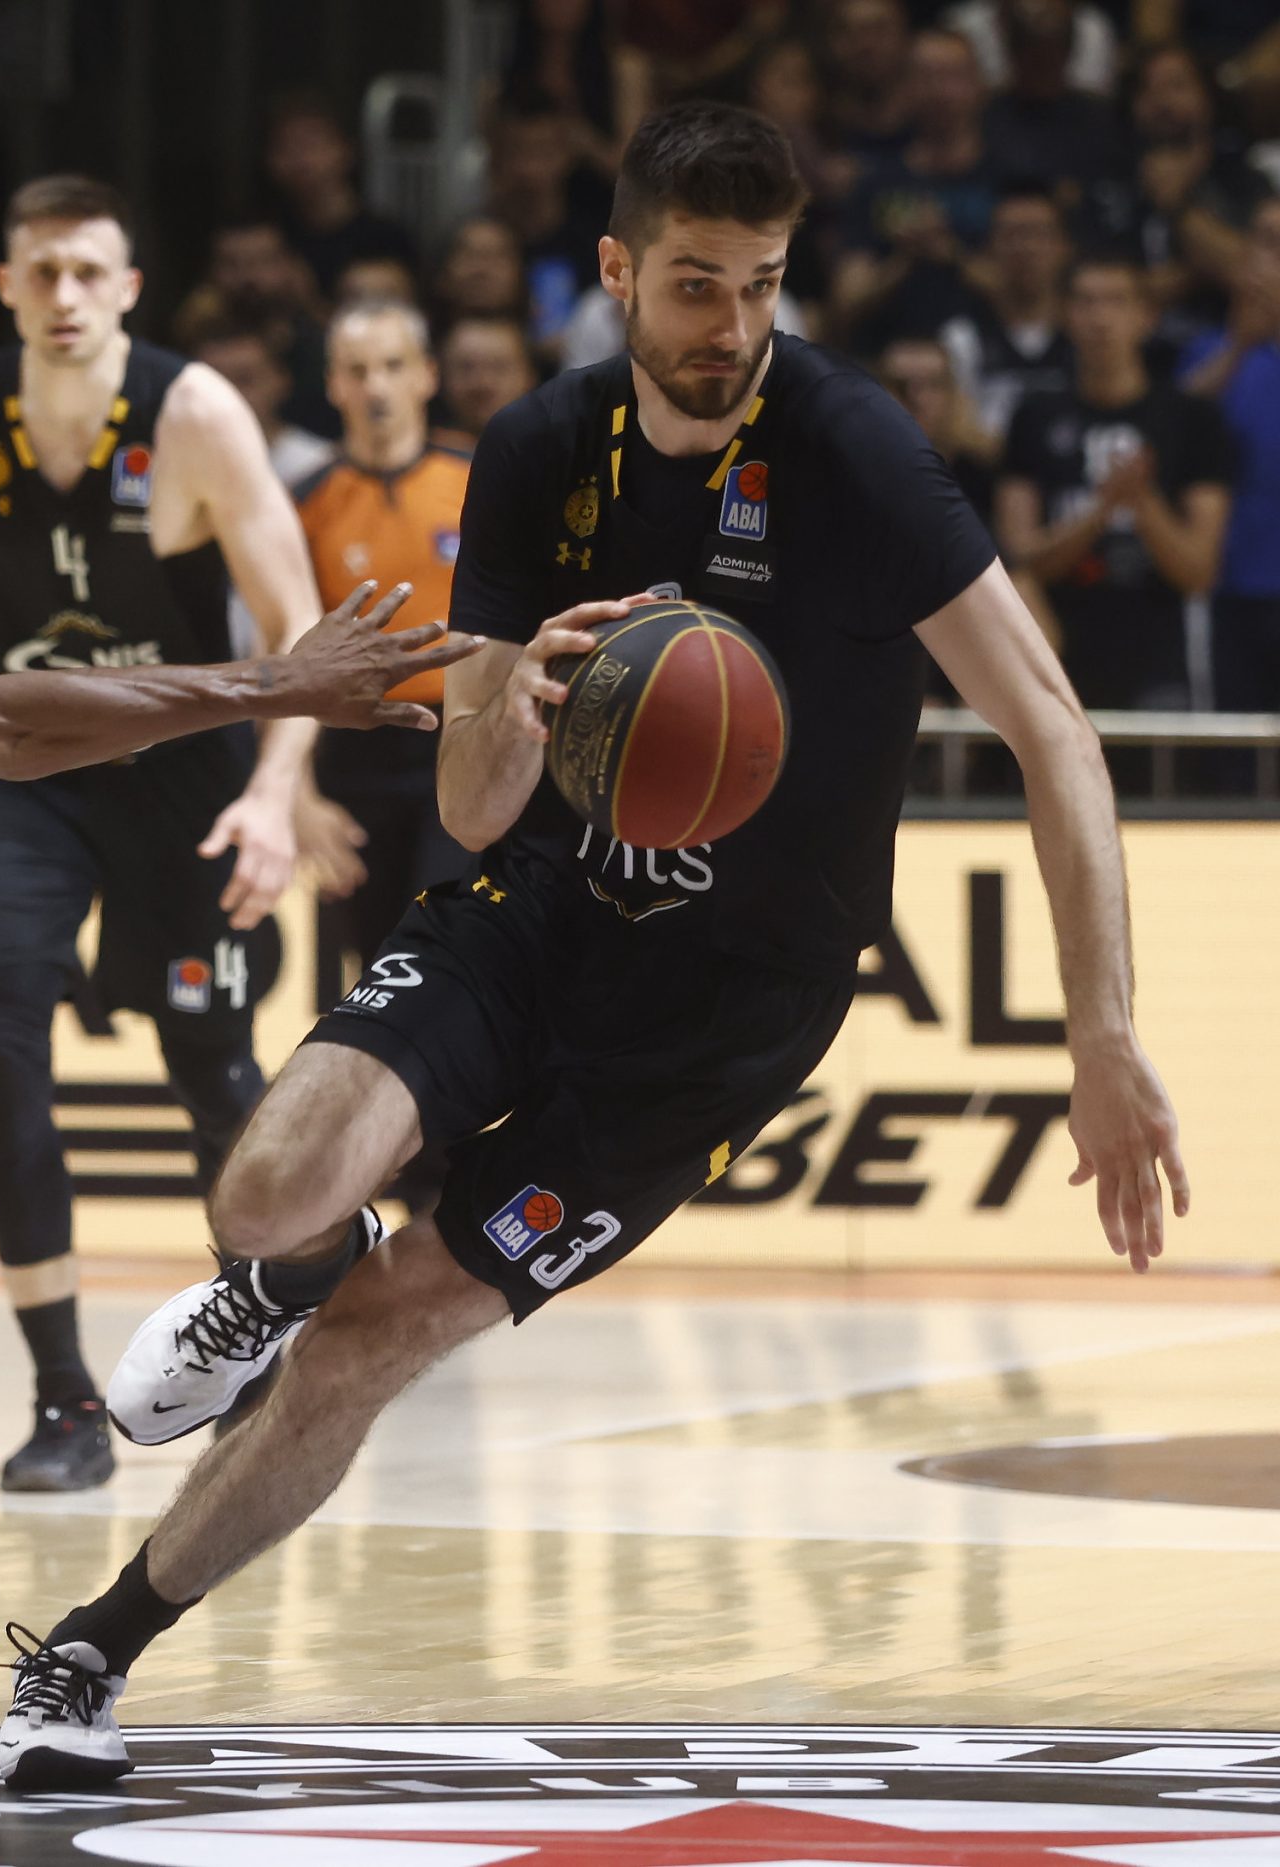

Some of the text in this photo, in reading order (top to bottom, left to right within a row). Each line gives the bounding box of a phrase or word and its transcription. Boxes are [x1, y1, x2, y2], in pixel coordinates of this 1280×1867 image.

[726, 502, 760, 532] ABA
[51, 524, 90, 601] 4
[710, 554, 773, 576] ADMIRAL
[214, 938, 249, 1010] 4
[345, 987, 395, 1009] NIS
[687, 1089, 1072, 1209] BET
[491, 1213, 530, 1253] ABA
[529, 1211, 621, 1290] 3
